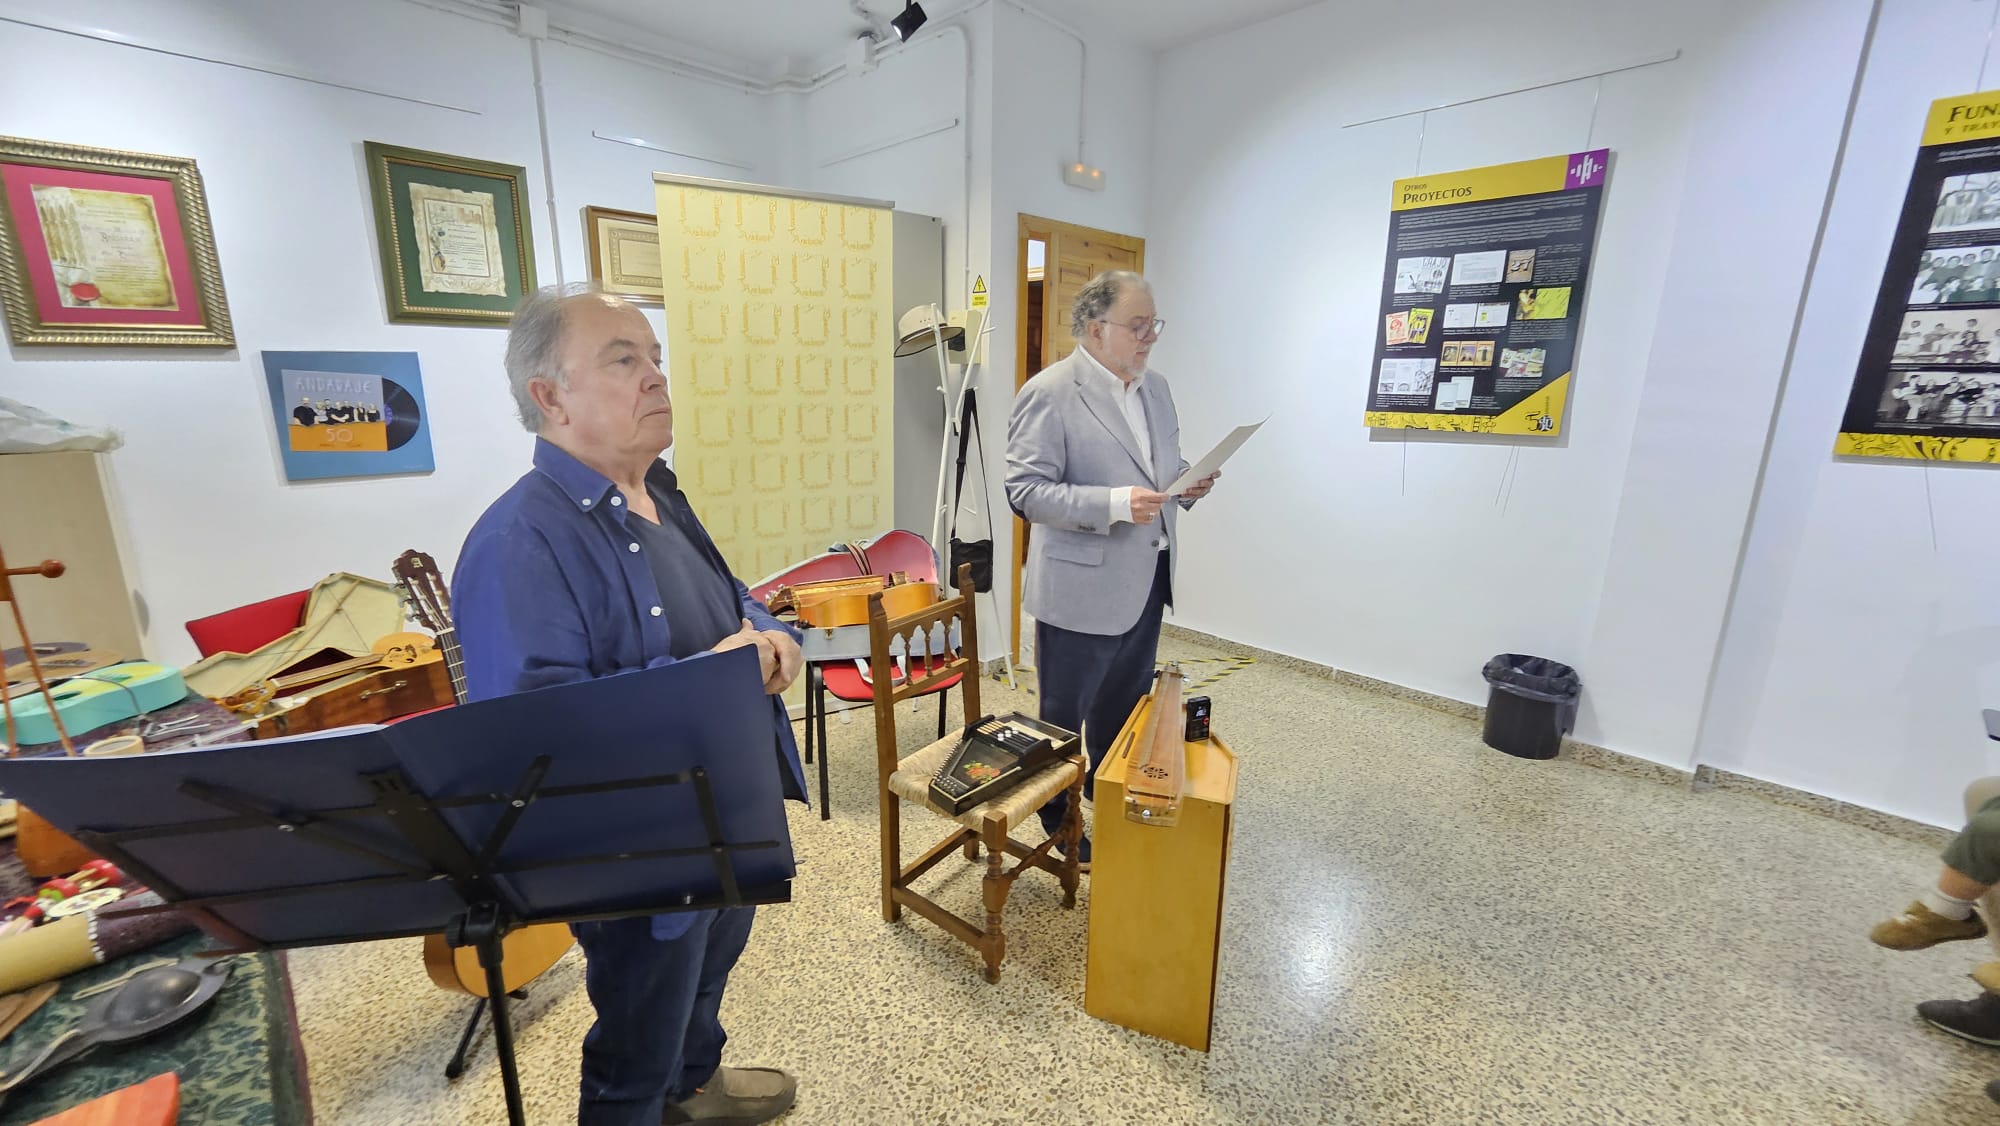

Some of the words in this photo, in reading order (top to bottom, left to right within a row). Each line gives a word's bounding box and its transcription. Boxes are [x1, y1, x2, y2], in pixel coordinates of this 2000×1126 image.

[1947, 103, 2000, 123] FUN
[1962, 120, 2000, 133] TRAY
[1402, 186, 1473, 204] PROYECTOS
[326, 427, 353, 443] 50
